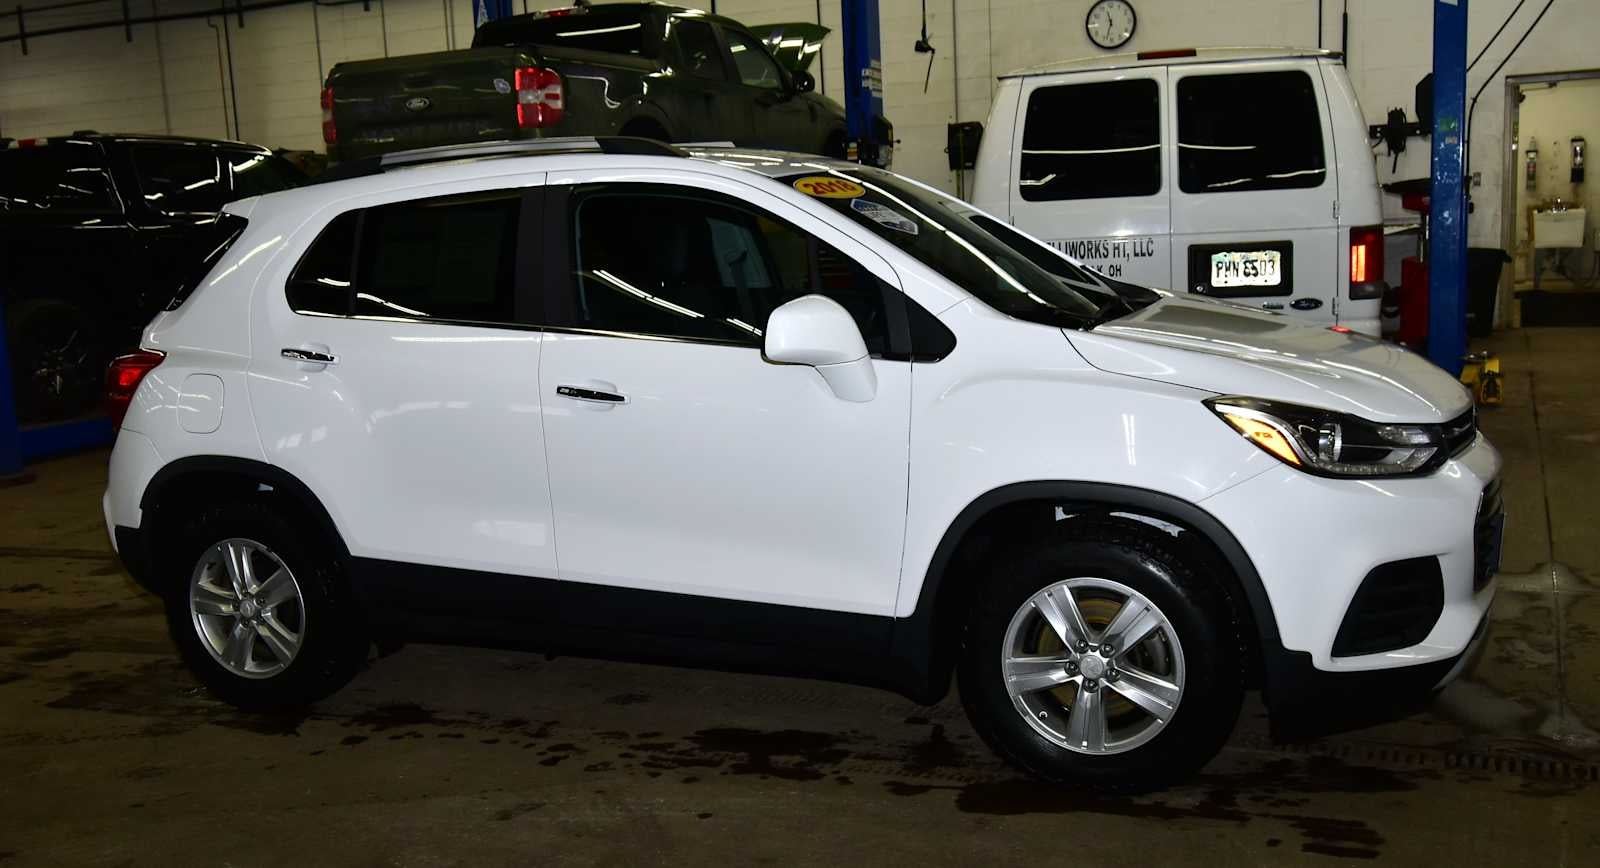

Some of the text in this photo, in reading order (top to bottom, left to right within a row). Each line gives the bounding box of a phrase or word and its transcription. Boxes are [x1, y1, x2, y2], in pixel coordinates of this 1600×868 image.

[1113, 239, 1130, 261] HT,
[1133, 237, 1154, 258] LLC
[1109, 264, 1122, 278] OH
